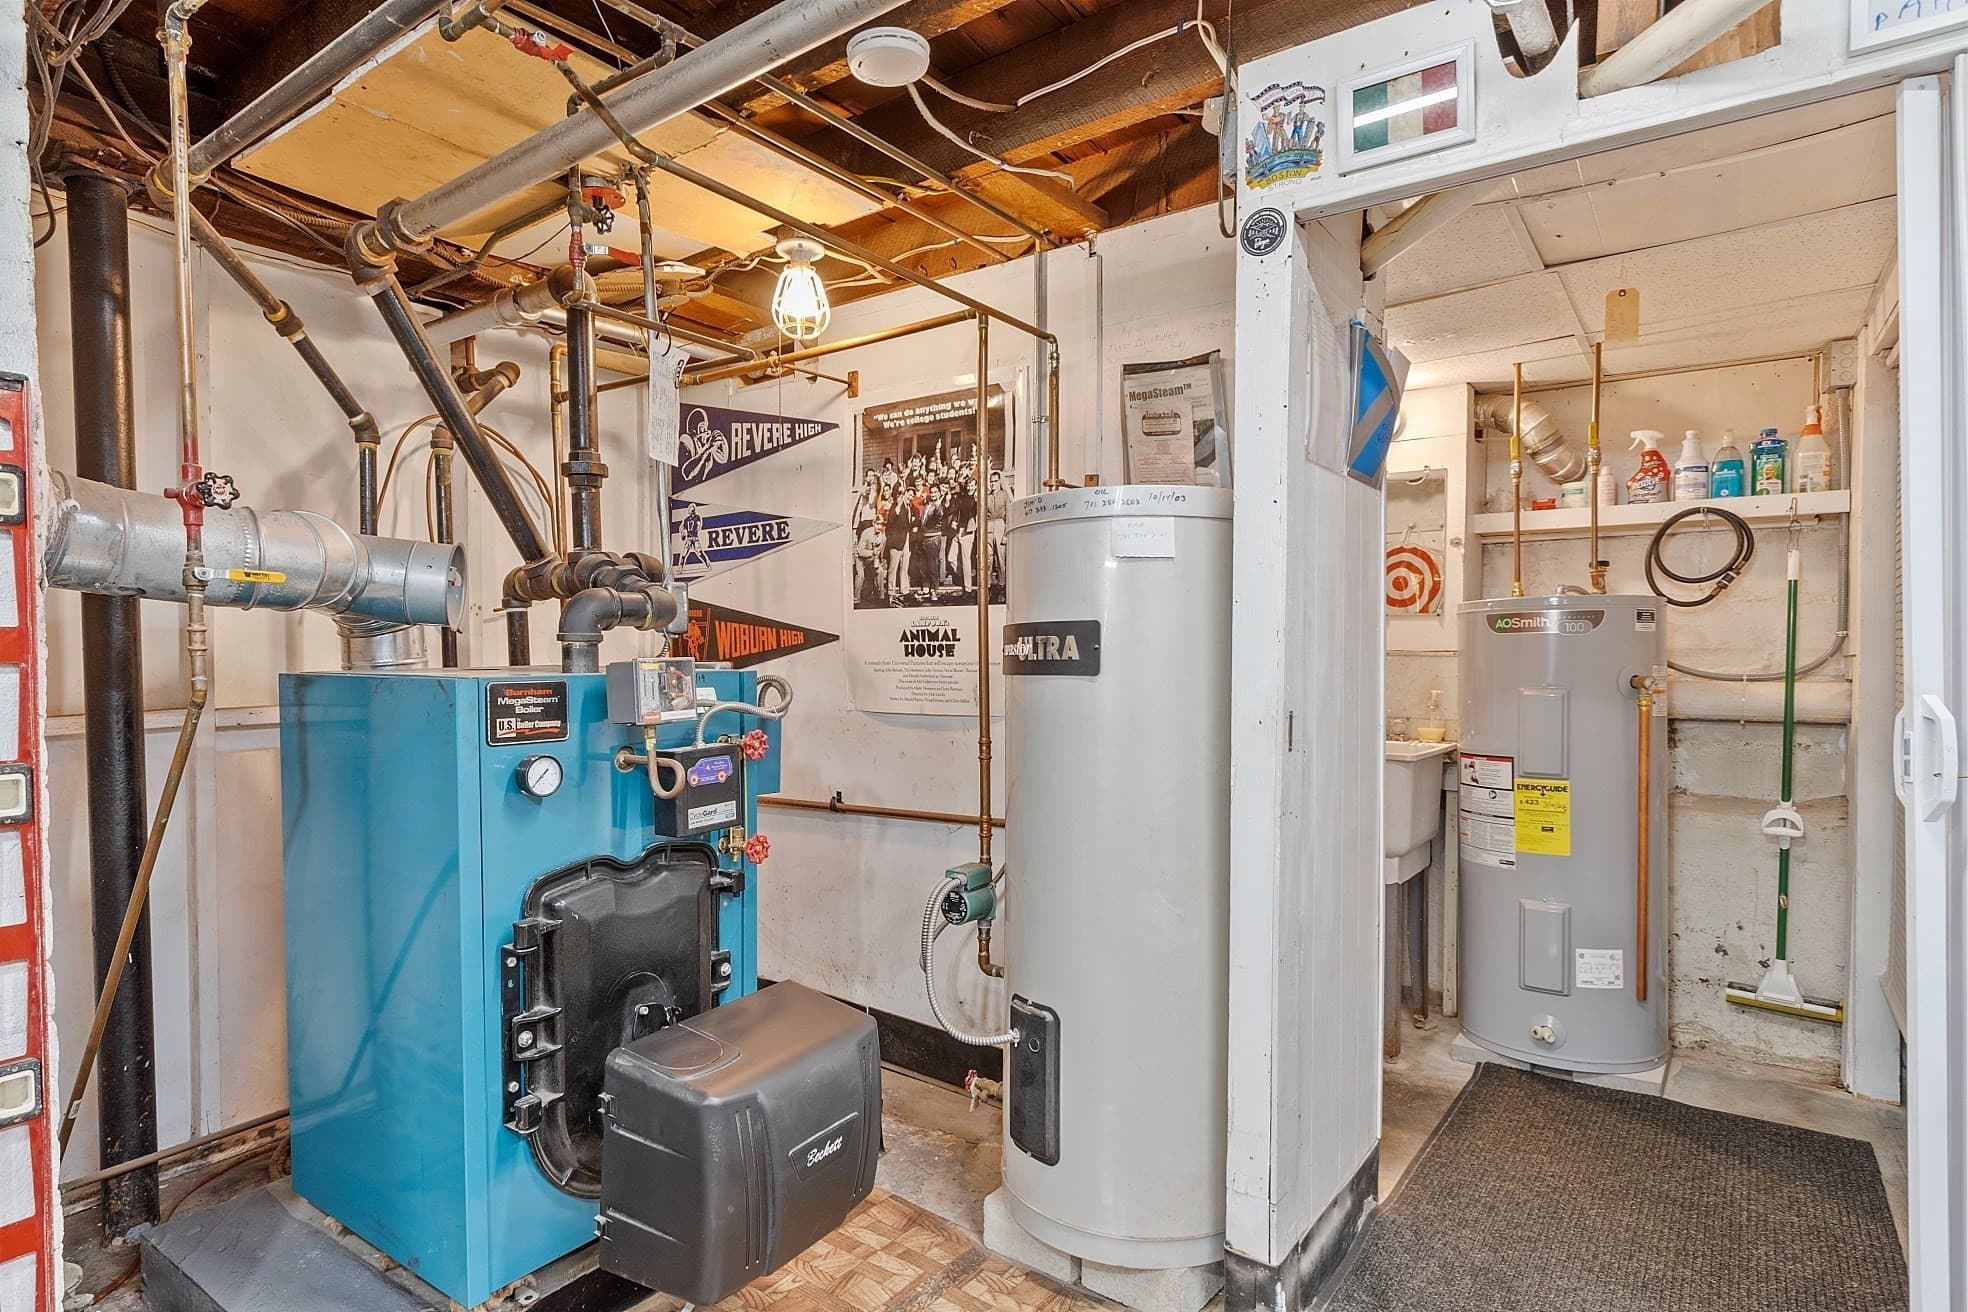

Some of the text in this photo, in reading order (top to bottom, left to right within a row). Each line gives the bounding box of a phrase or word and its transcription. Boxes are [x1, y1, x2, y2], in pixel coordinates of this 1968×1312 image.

[1265, 169, 1302, 185] BOSTON
[1267, 178, 1302, 191] STRONG
[889, 411, 903, 420] can
[903, 408, 914, 417] do
[914, 400, 952, 415] anything
[953, 399, 966, 407] we
[883, 419, 905, 429] We're
[906, 414, 935, 426] college
[730, 421, 822, 463] REVERE HIGH
[707, 520, 791, 549] REVERE
[1564, 622, 1585, 633] 100
[714, 620, 805, 661] WOBURN HIGH
[899, 628, 961, 643] ANIMAL
[903, 643, 956, 658] HOUSE
[1018, 634, 1080, 661] ULTRA
[504, 688, 553, 696] Burnham
[515, 705, 544, 714] Boiler
[498, 720, 515, 731] U.S.
[516, 720, 534, 729] Boiler
[807, 1135, 843, 1168] Beckett
